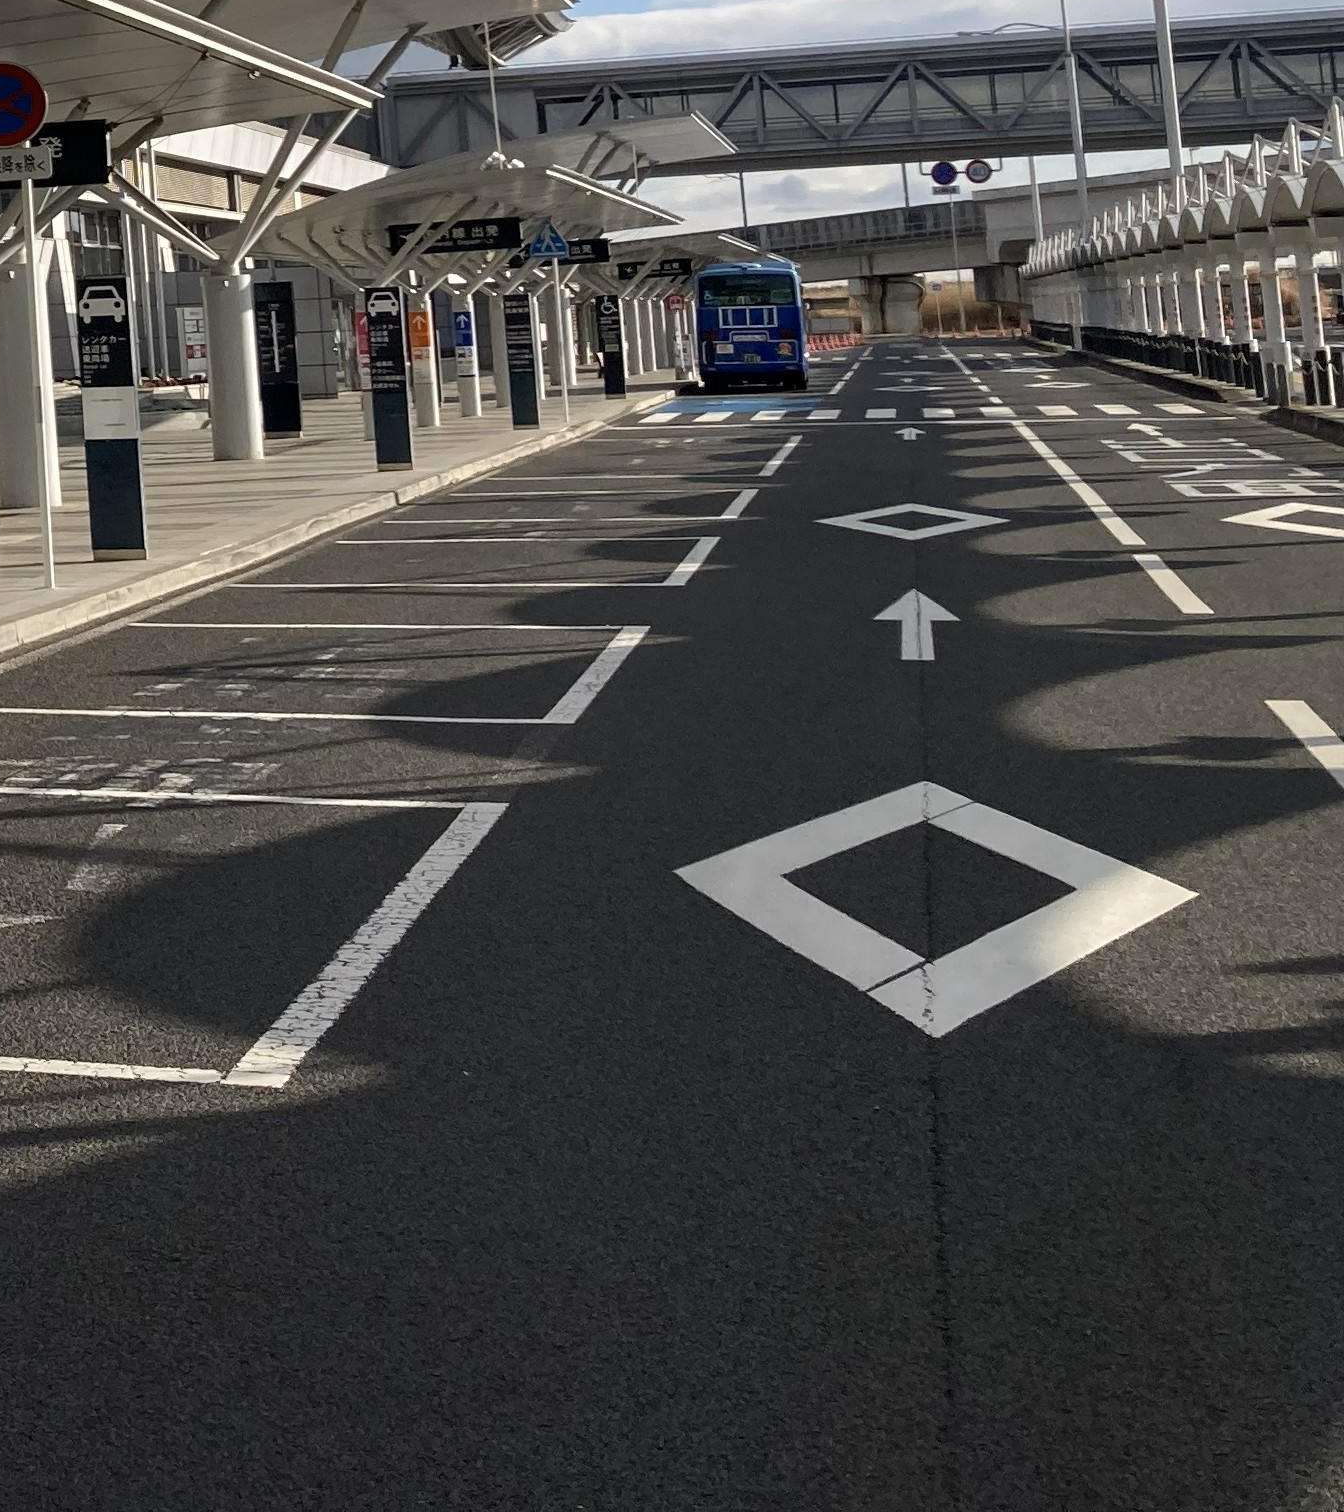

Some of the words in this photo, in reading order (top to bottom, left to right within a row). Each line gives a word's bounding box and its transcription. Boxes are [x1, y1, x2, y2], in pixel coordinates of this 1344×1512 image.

[81, 335, 127, 344] レンタカー
